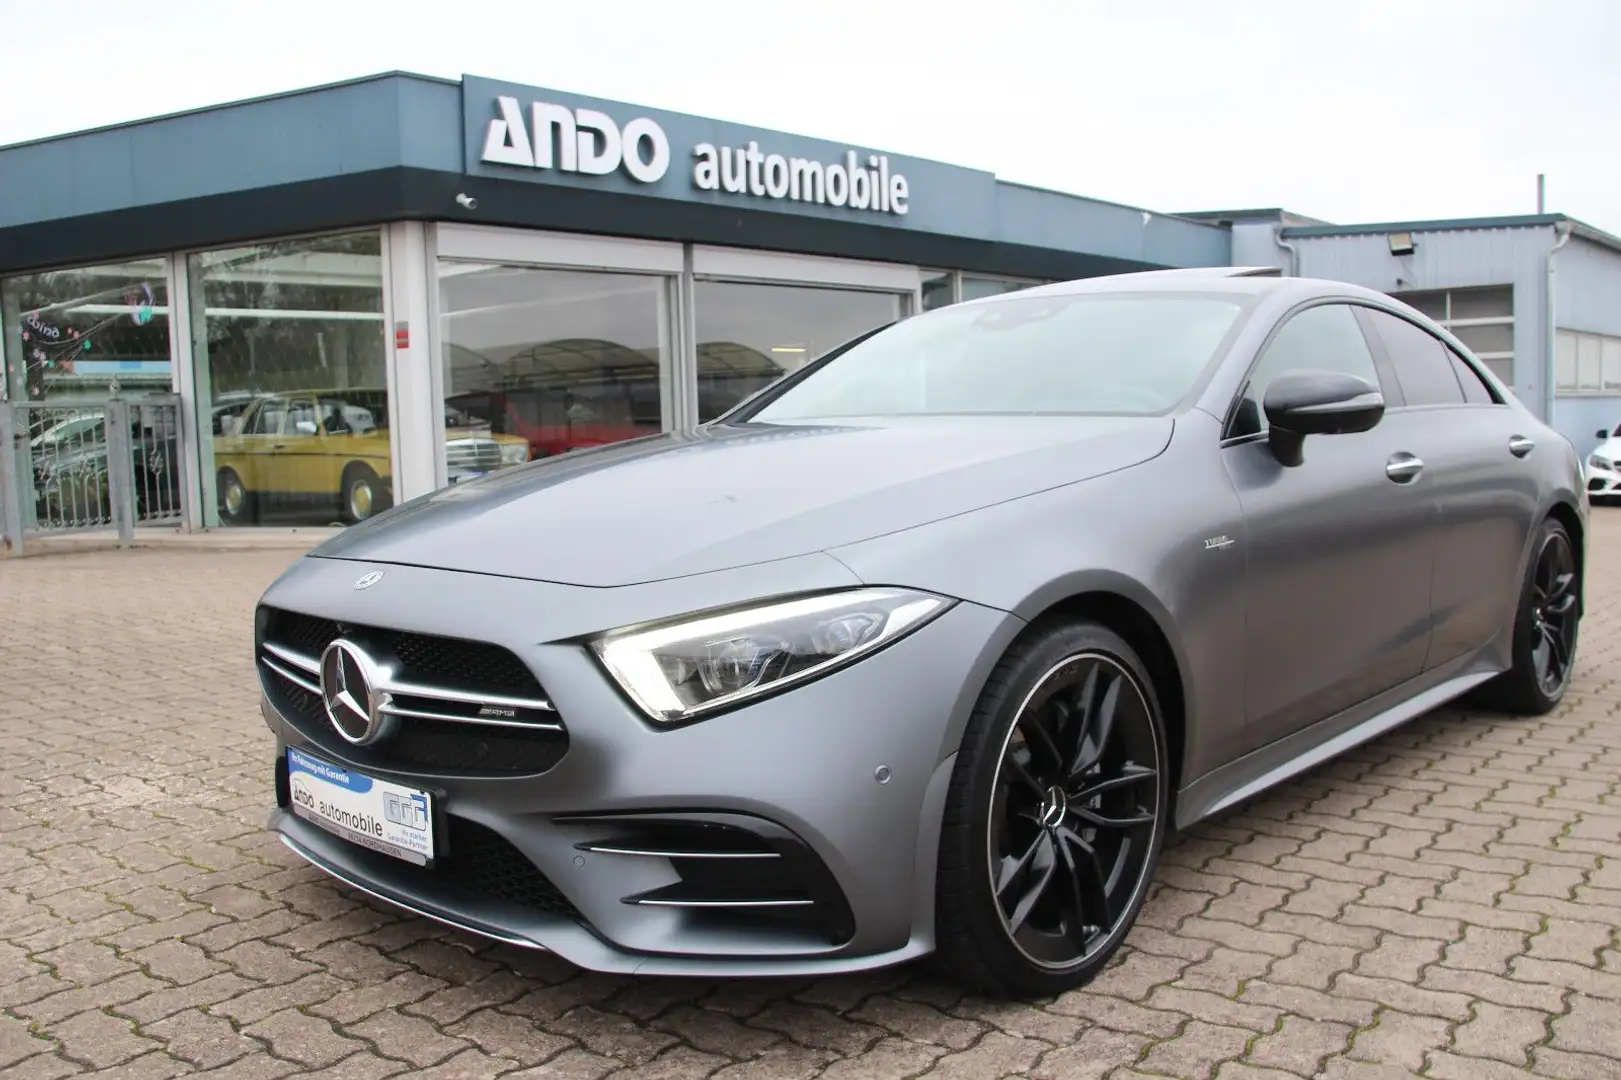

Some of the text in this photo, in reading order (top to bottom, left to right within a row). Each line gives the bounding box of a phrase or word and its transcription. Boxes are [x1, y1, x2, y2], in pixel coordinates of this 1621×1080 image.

[481, 95, 910, 215] ANDO automobile
[326, 767, 350, 784] Garantie
[294, 786, 315, 809] ANDO
[319, 800, 384, 837] automobile
